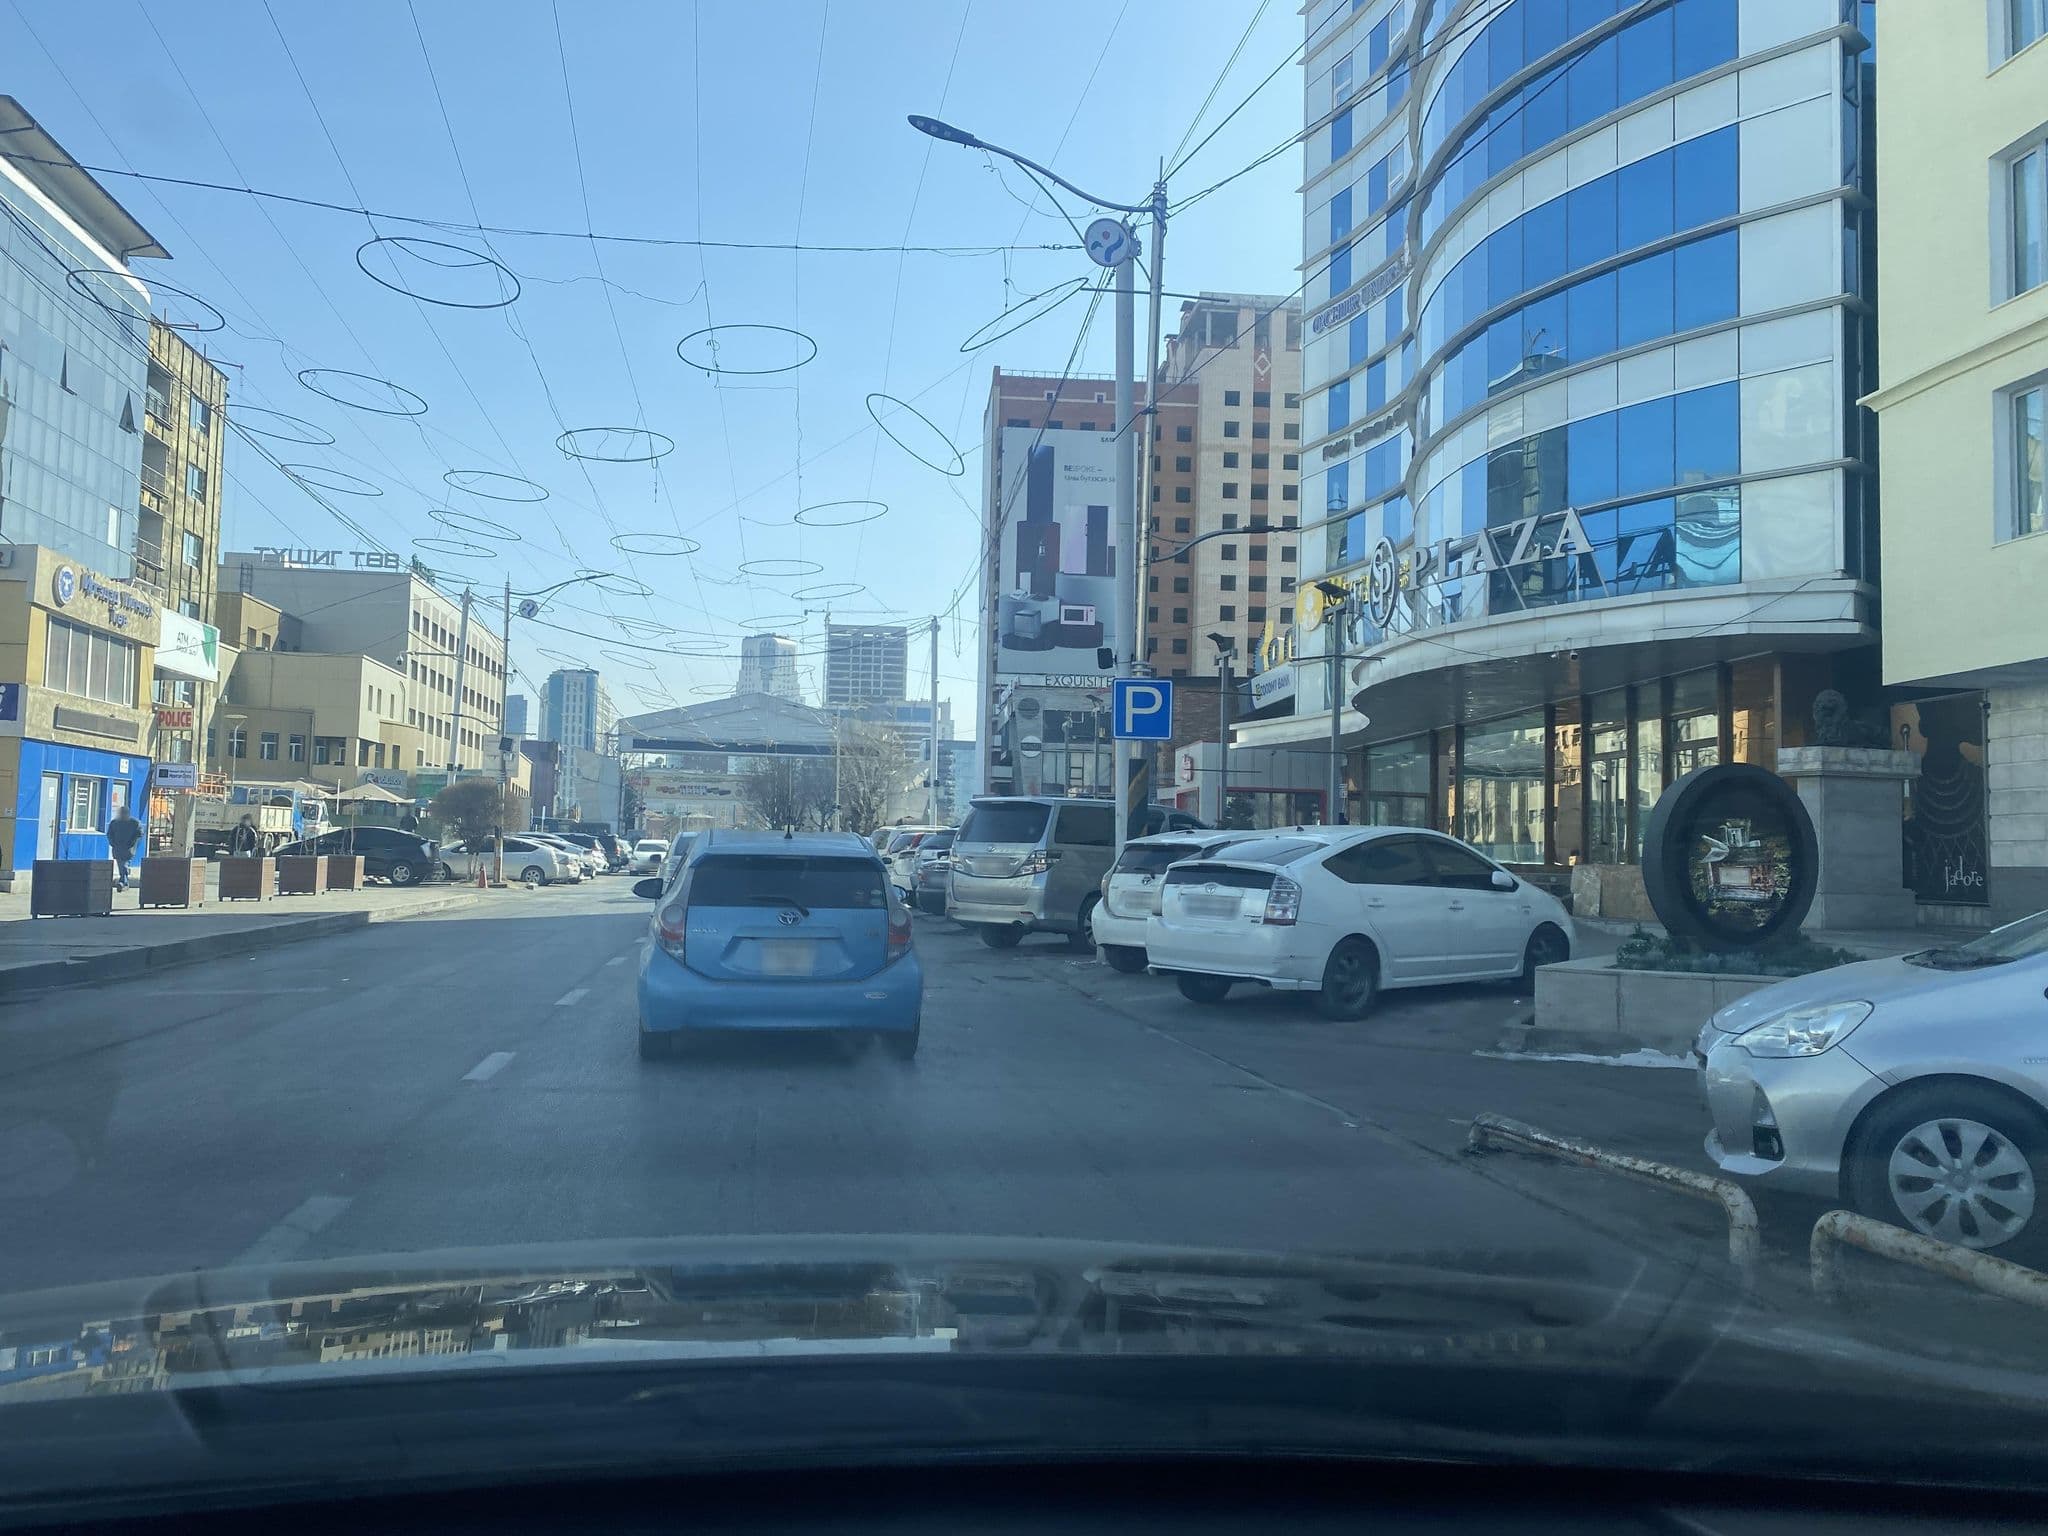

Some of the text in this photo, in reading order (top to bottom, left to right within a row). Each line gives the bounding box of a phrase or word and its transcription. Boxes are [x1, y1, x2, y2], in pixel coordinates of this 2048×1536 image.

[1408, 507, 1594, 591] PLAZA
[158, 710, 192, 728] POLICE
[1124, 685, 1163, 734] P
[1944, 855, 1984, 893] j'adore
